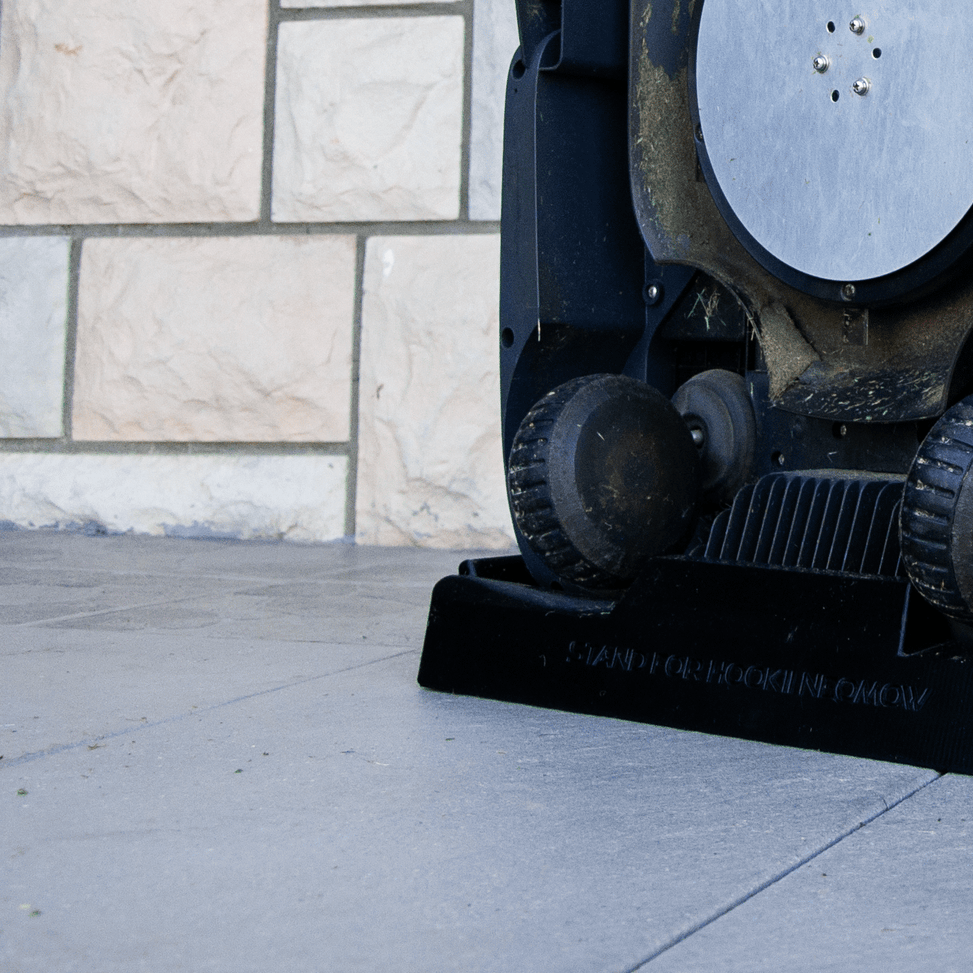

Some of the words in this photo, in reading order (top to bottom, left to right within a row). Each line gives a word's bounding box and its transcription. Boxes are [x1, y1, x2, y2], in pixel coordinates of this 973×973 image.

[566, 639, 647, 673] STAND
[649, 651, 704, 682] FOR
[706, 659, 795, 695] HOOKII
